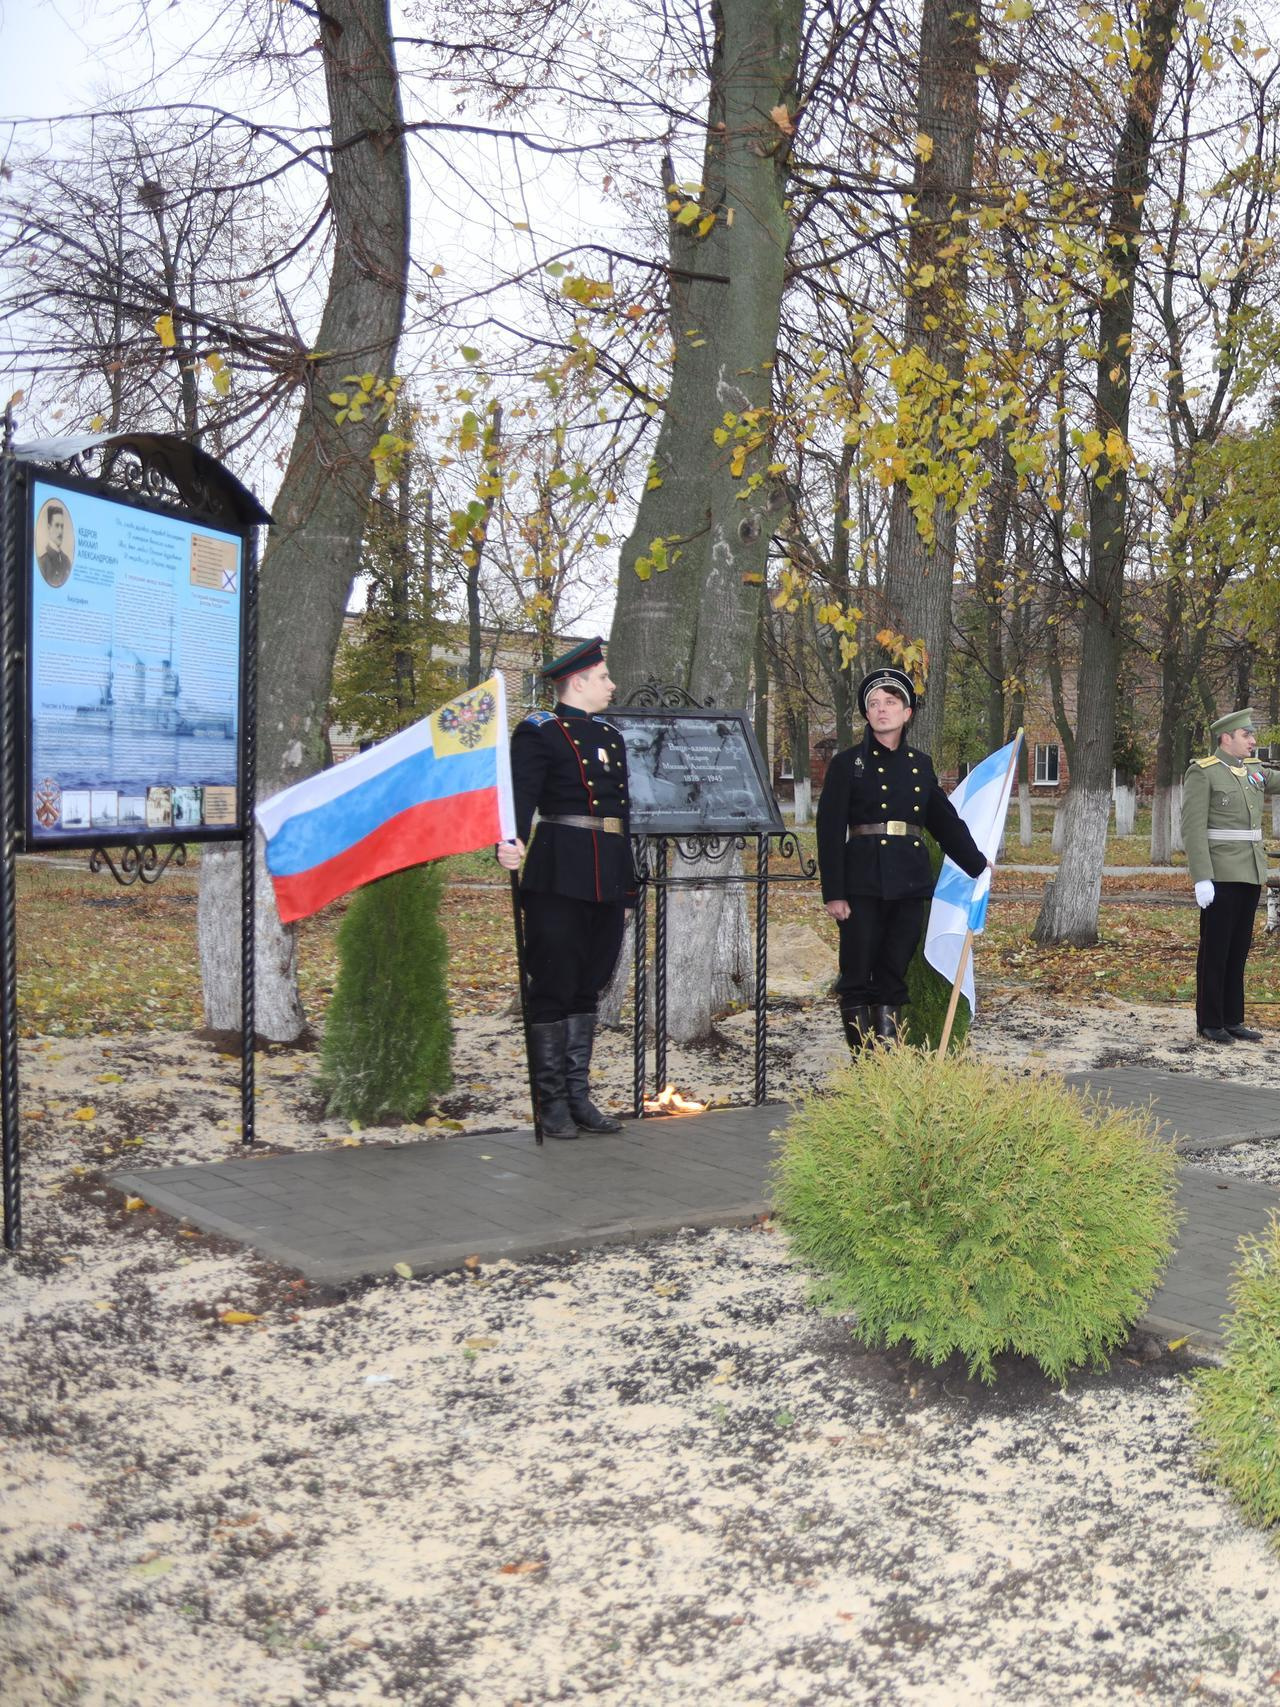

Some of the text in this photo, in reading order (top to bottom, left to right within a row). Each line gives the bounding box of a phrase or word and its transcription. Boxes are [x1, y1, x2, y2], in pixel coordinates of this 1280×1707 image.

[78, 528, 97, 539] КЕДРОВ
[78, 539, 98, 550] МИХАИЛ
[78, 551, 119, 565] АЛЕКСАНДРОВИЧ
[668, 743, 721, 752] Вице-адмирал
[662, 762, 737, 772] Михаил Александрович
[707, 775, 722, 783] 1945
